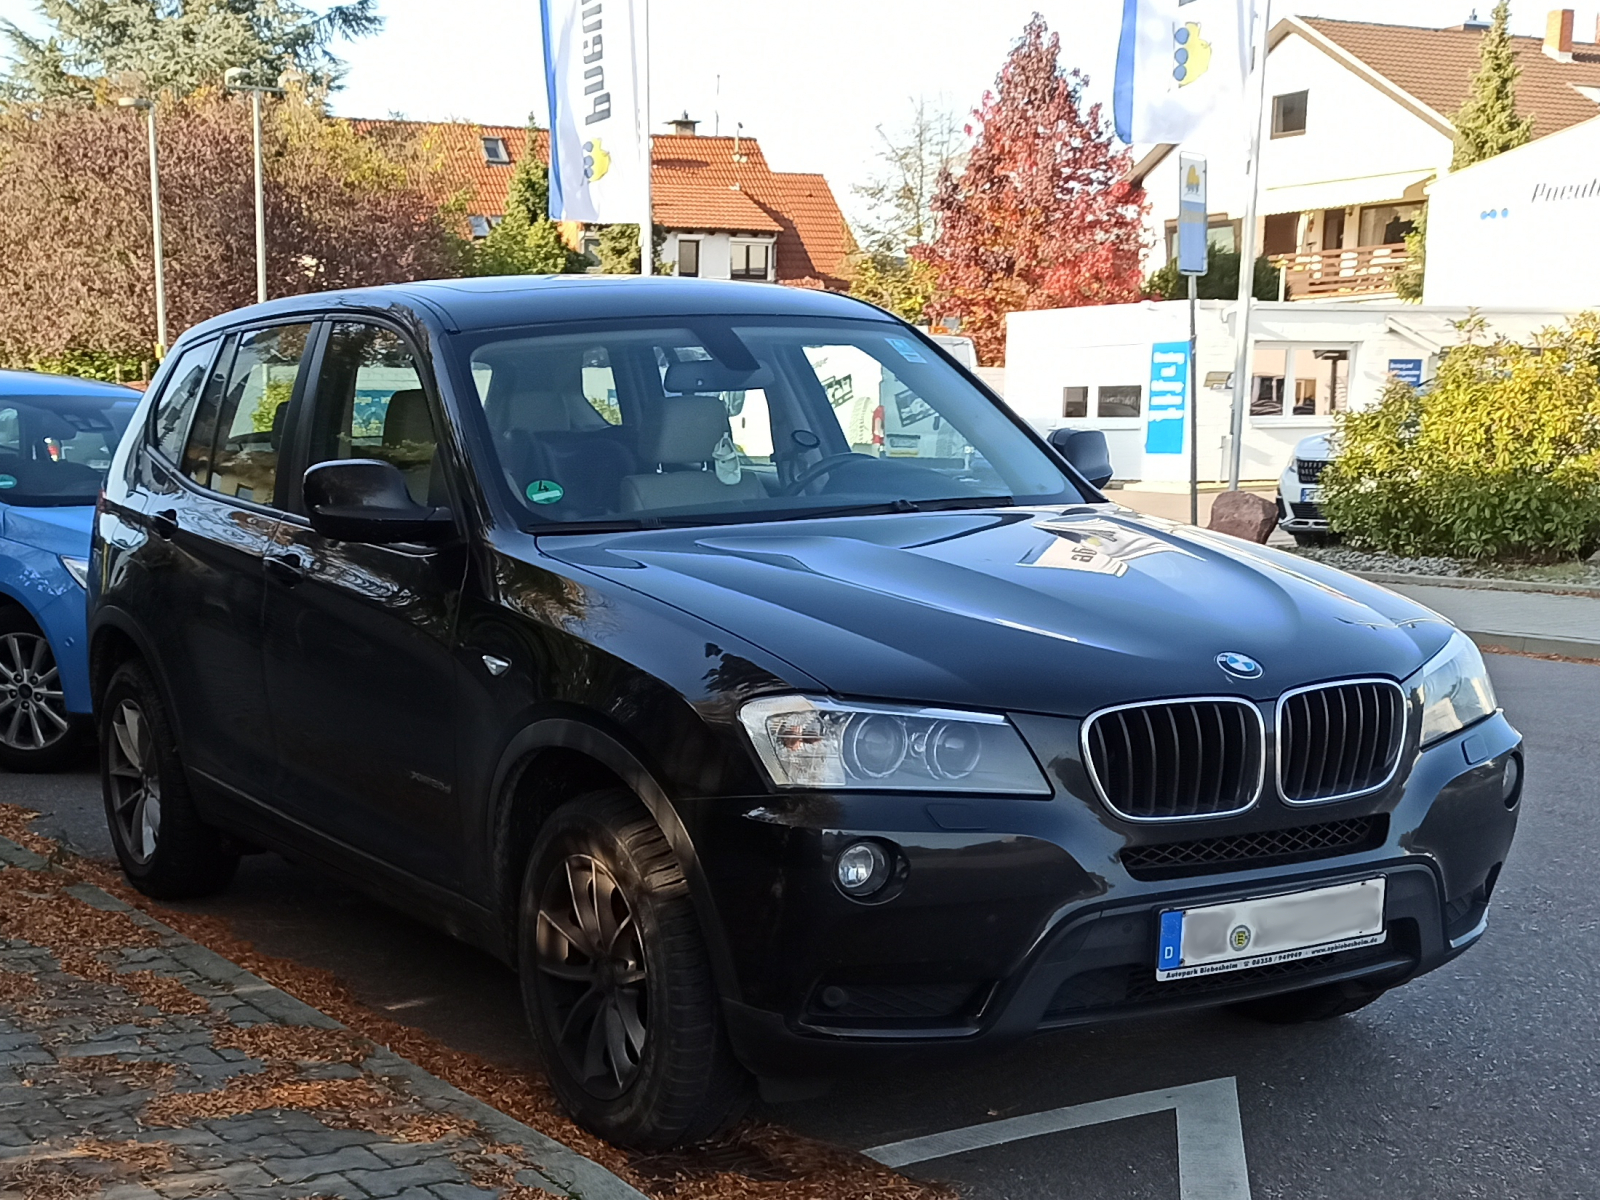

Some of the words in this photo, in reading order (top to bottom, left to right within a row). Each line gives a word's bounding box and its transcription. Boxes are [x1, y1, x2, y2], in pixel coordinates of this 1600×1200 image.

[538, 480, 550, 492] 4
[1164, 946, 1174, 960] D
[1166, 968, 1198, 979] Autopark
